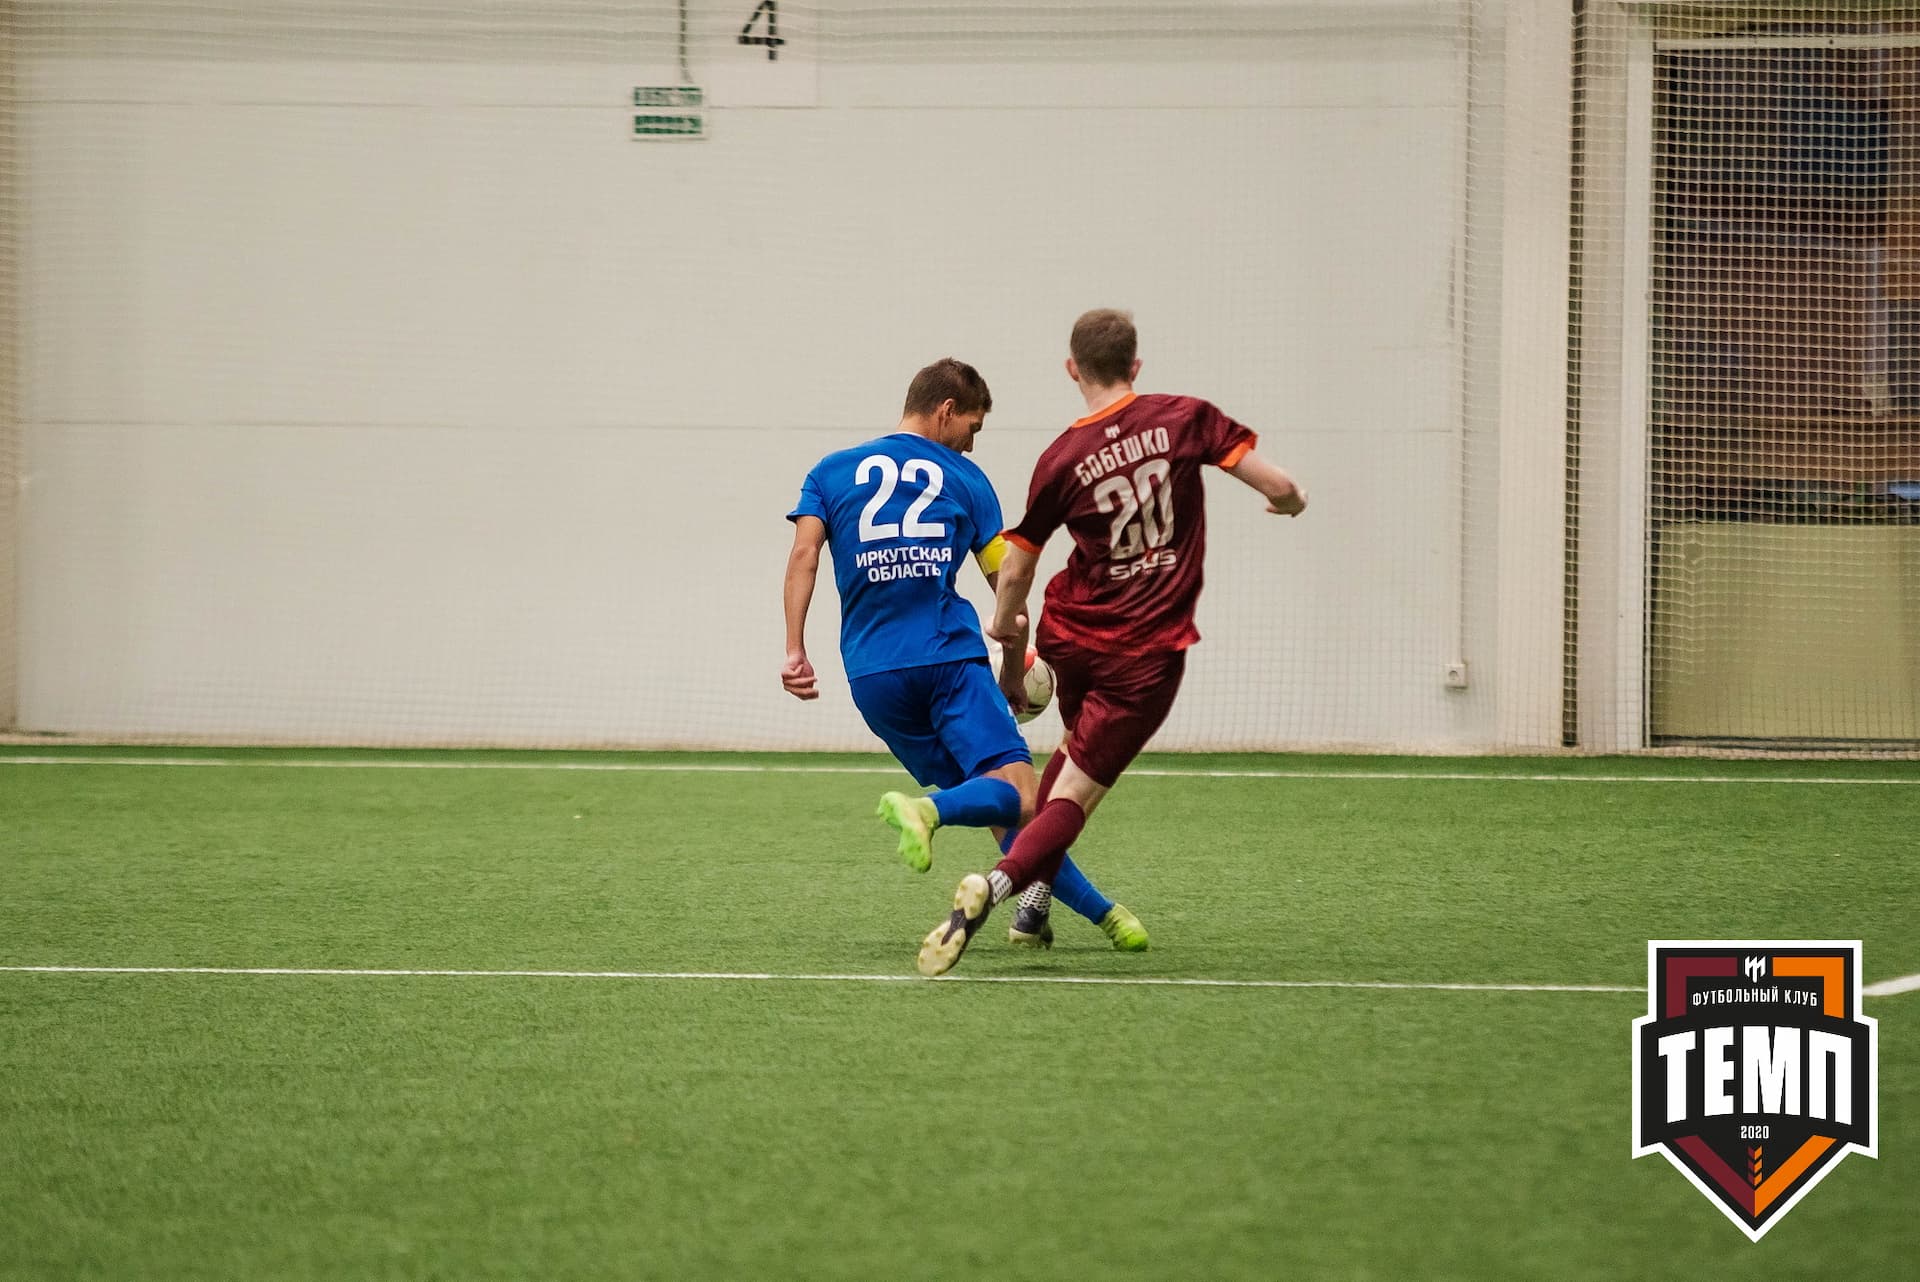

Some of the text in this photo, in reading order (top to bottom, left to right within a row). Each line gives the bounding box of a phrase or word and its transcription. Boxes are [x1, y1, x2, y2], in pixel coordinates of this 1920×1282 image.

[738, 0, 785, 60] 4
[1074, 427, 1170, 486] БОБЕШКО
[855, 454, 945, 542] 22
[1094, 458, 1174, 560] 20
[855, 546, 952, 568] ИРКУТСКАЯ
[867, 562, 941, 582] ОБЛАСТЬ
